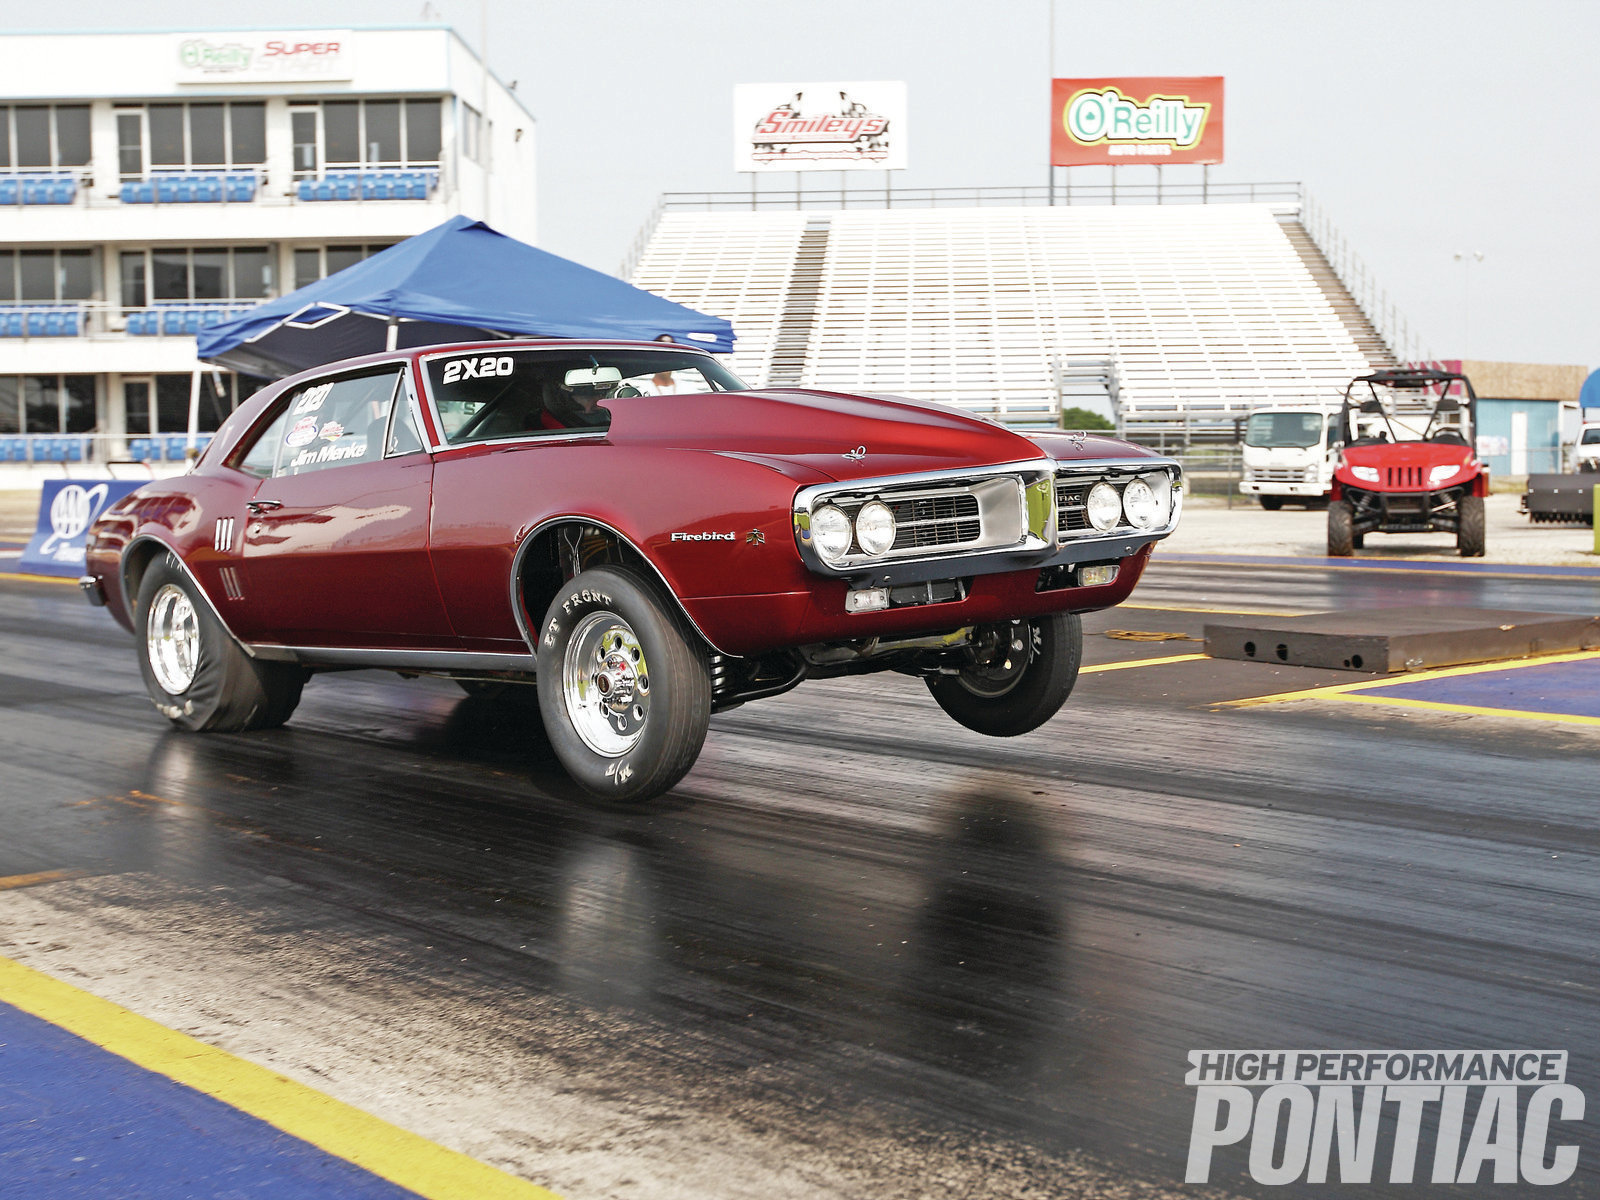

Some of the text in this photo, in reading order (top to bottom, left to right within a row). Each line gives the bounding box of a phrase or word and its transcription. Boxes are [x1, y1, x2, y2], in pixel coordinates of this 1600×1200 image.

[264, 41, 341, 56] SUPER
[1075, 97, 1197, 139] O'Reilly
[443, 357, 514, 384] 2X20
[290, 442, 367, 467] Jim Manke
[671, 531, 736, 542] Firebird
[543, 589, 613, 649] ET FRONT
